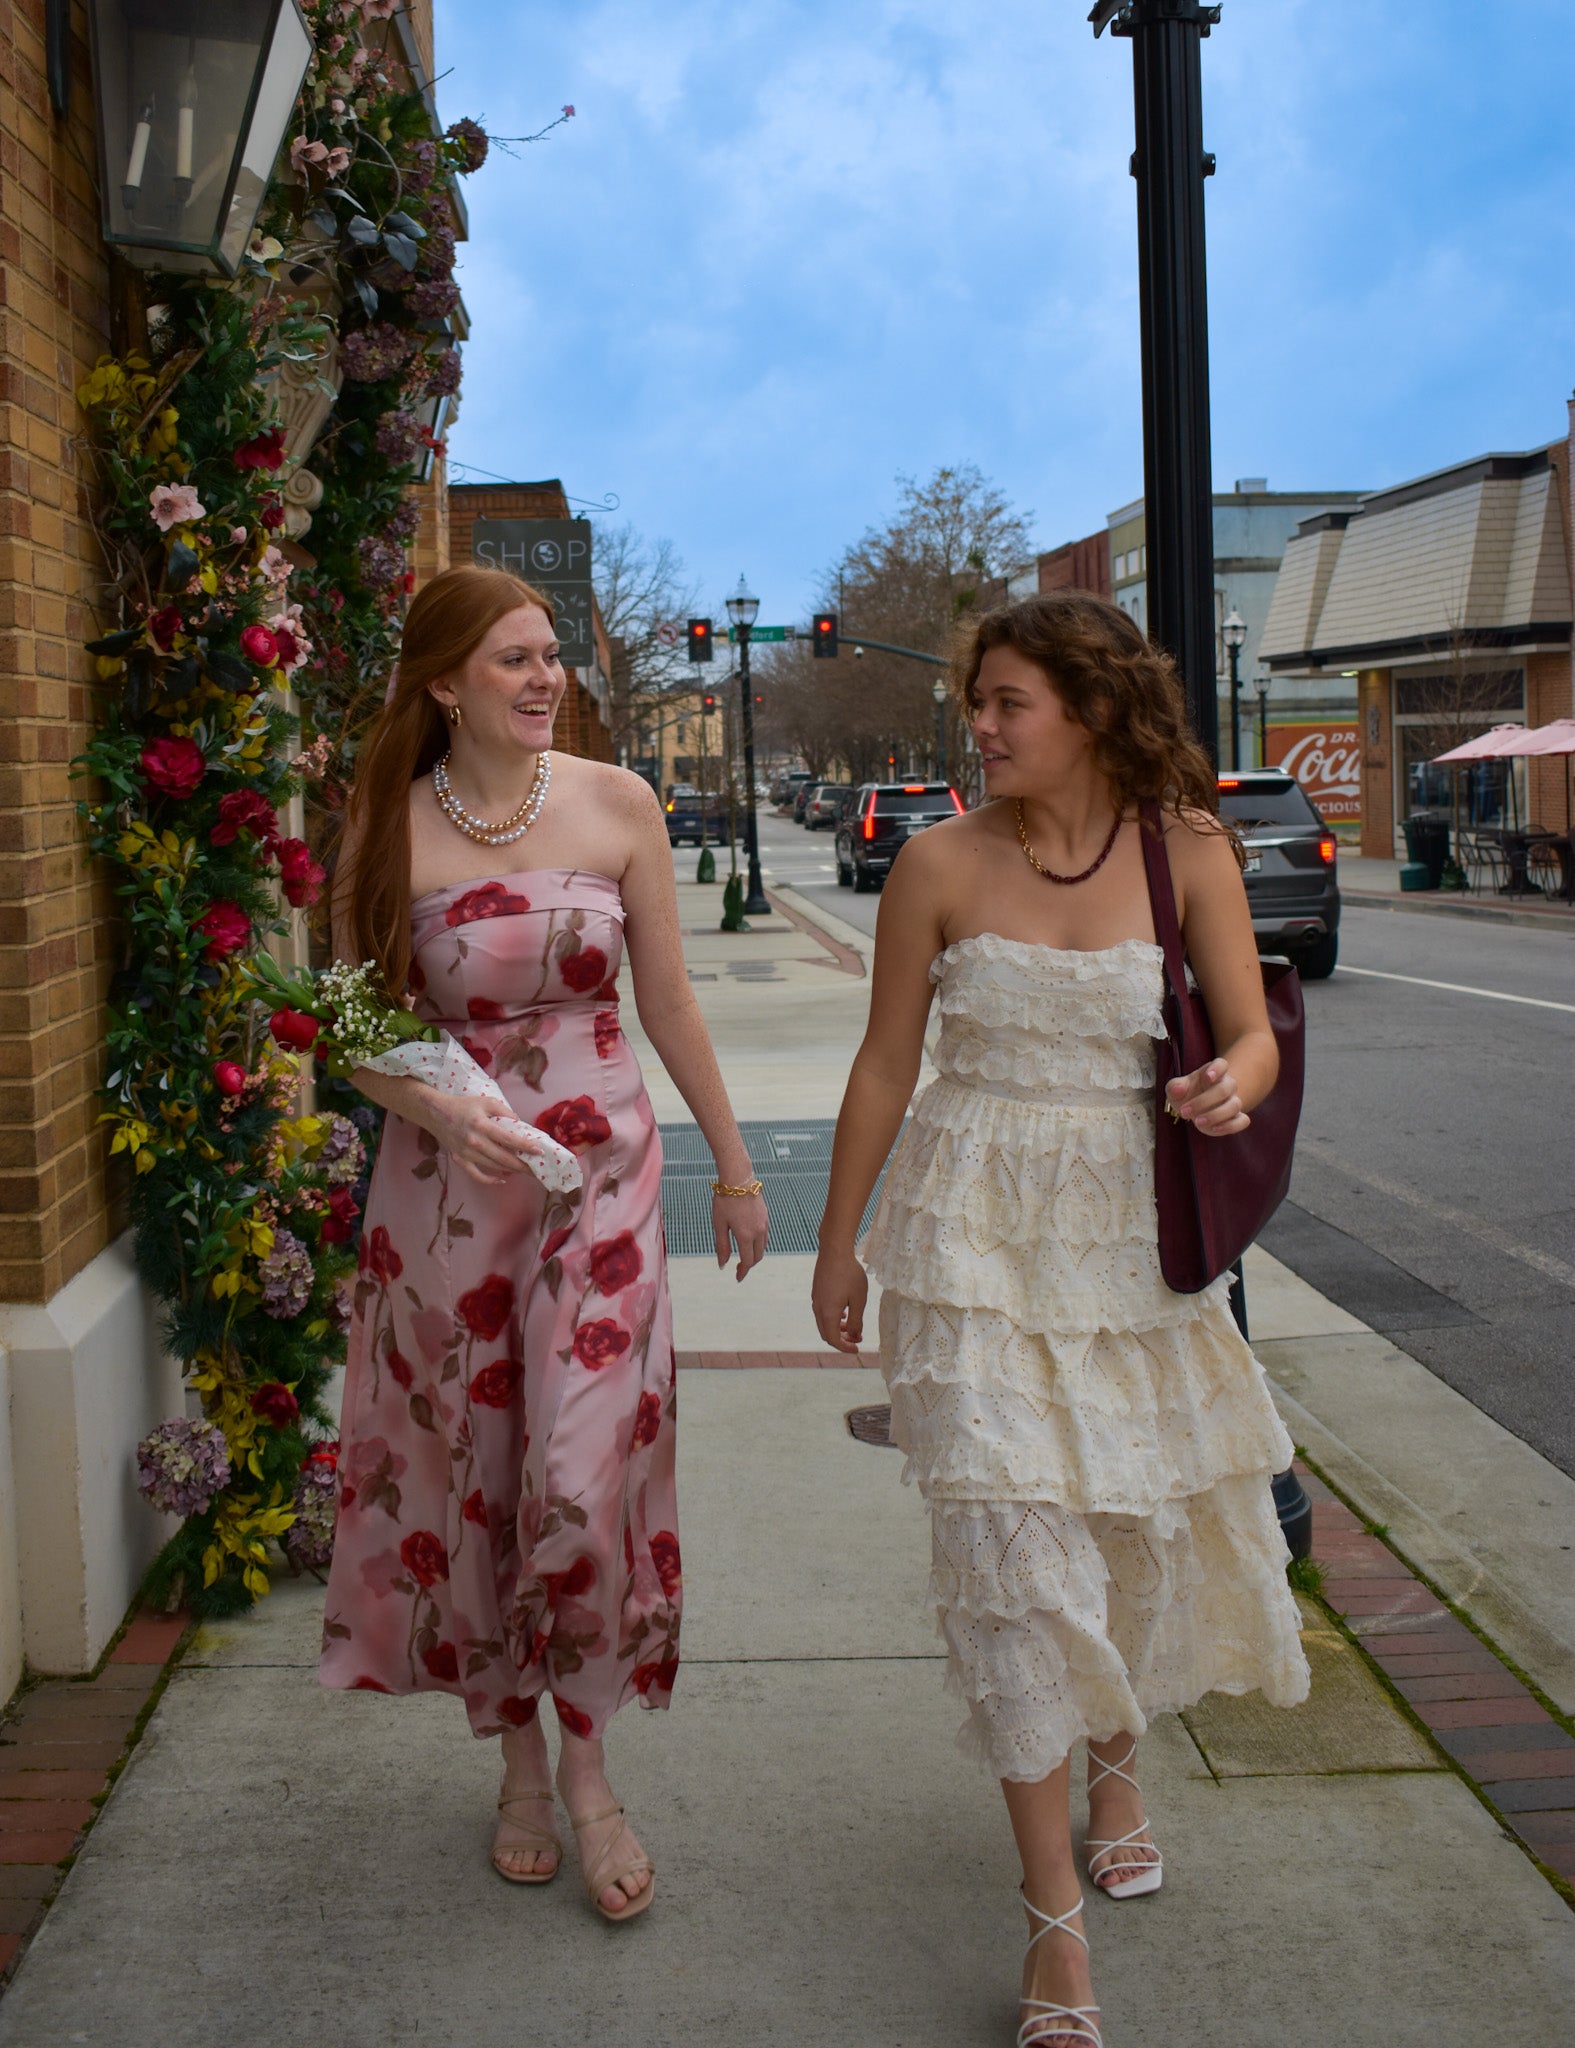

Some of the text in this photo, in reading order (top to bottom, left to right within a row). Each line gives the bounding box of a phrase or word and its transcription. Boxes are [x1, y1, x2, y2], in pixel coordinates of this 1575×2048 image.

[476, 539, 587, 571] SHOP
[1330, 732, 1360, 743] DR
[1315, 801, 1361, 814] CIOUS
